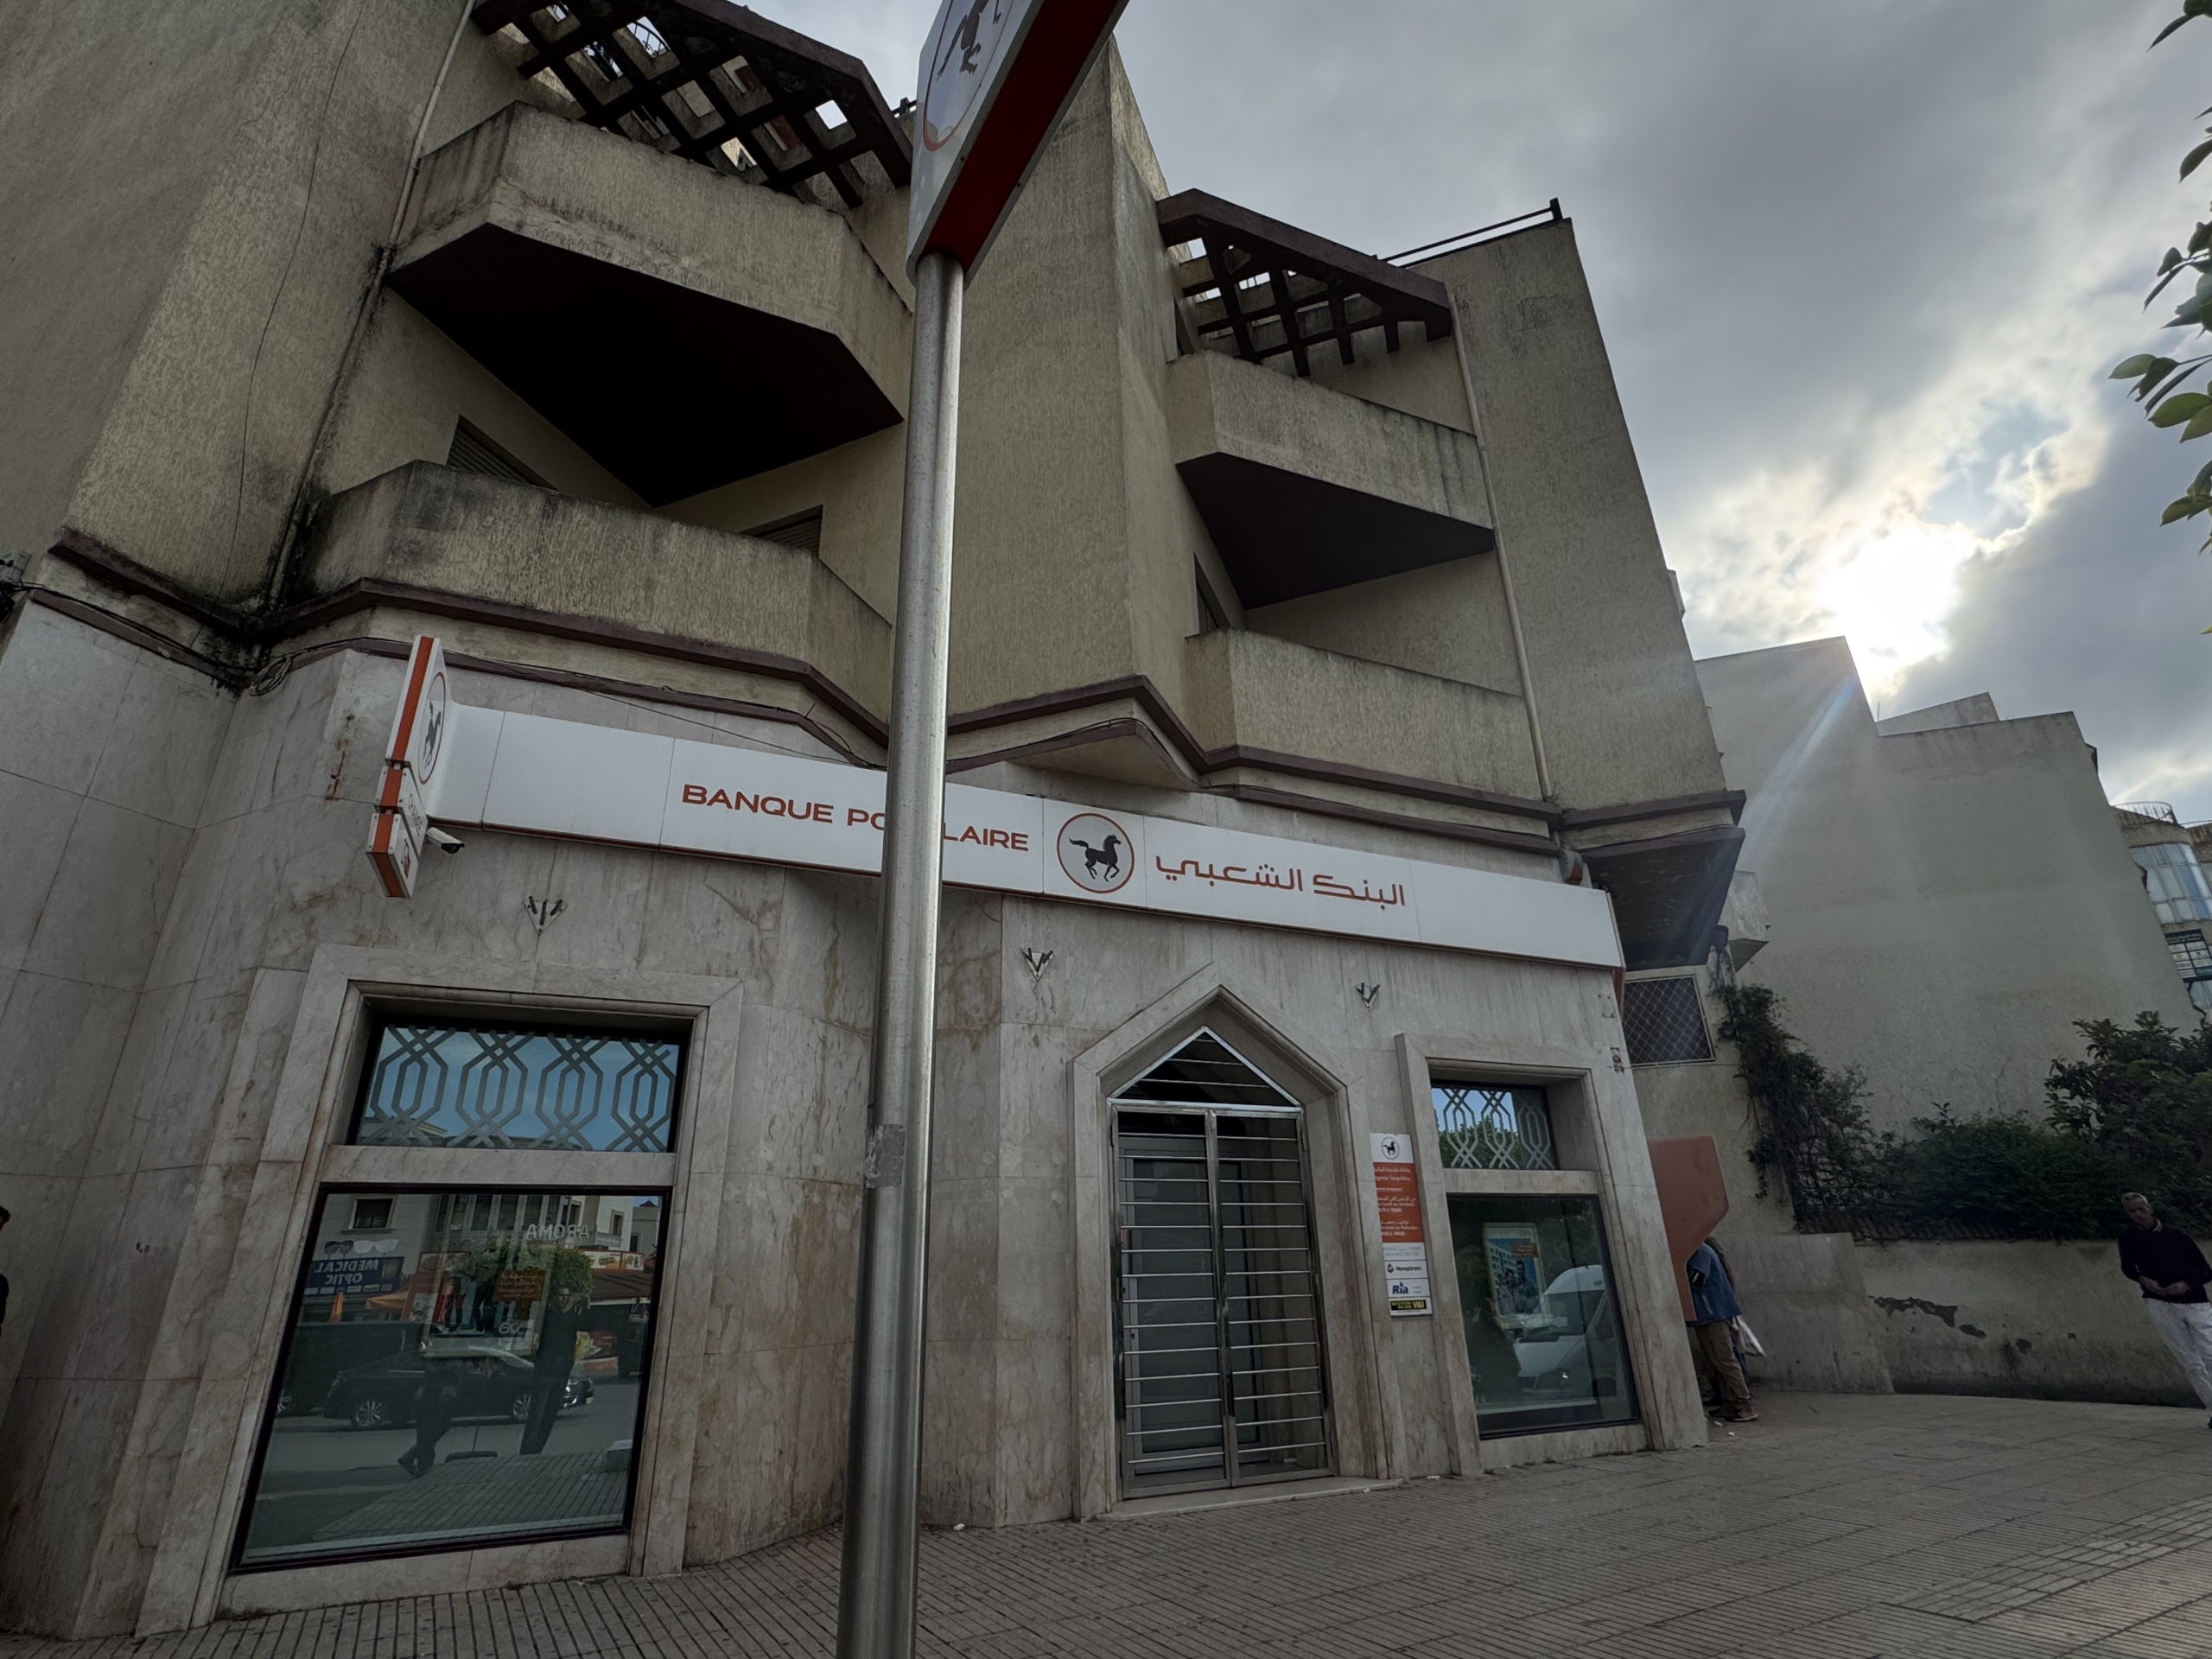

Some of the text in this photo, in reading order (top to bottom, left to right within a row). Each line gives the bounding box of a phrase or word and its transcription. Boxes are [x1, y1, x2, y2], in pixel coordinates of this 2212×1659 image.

[682, 784, 1029, 852] BANQUE POLAIRE
[1155, 855, 1406, 911] البنك الشعبي
[1392, 1283, 1409, 1294] Ria
